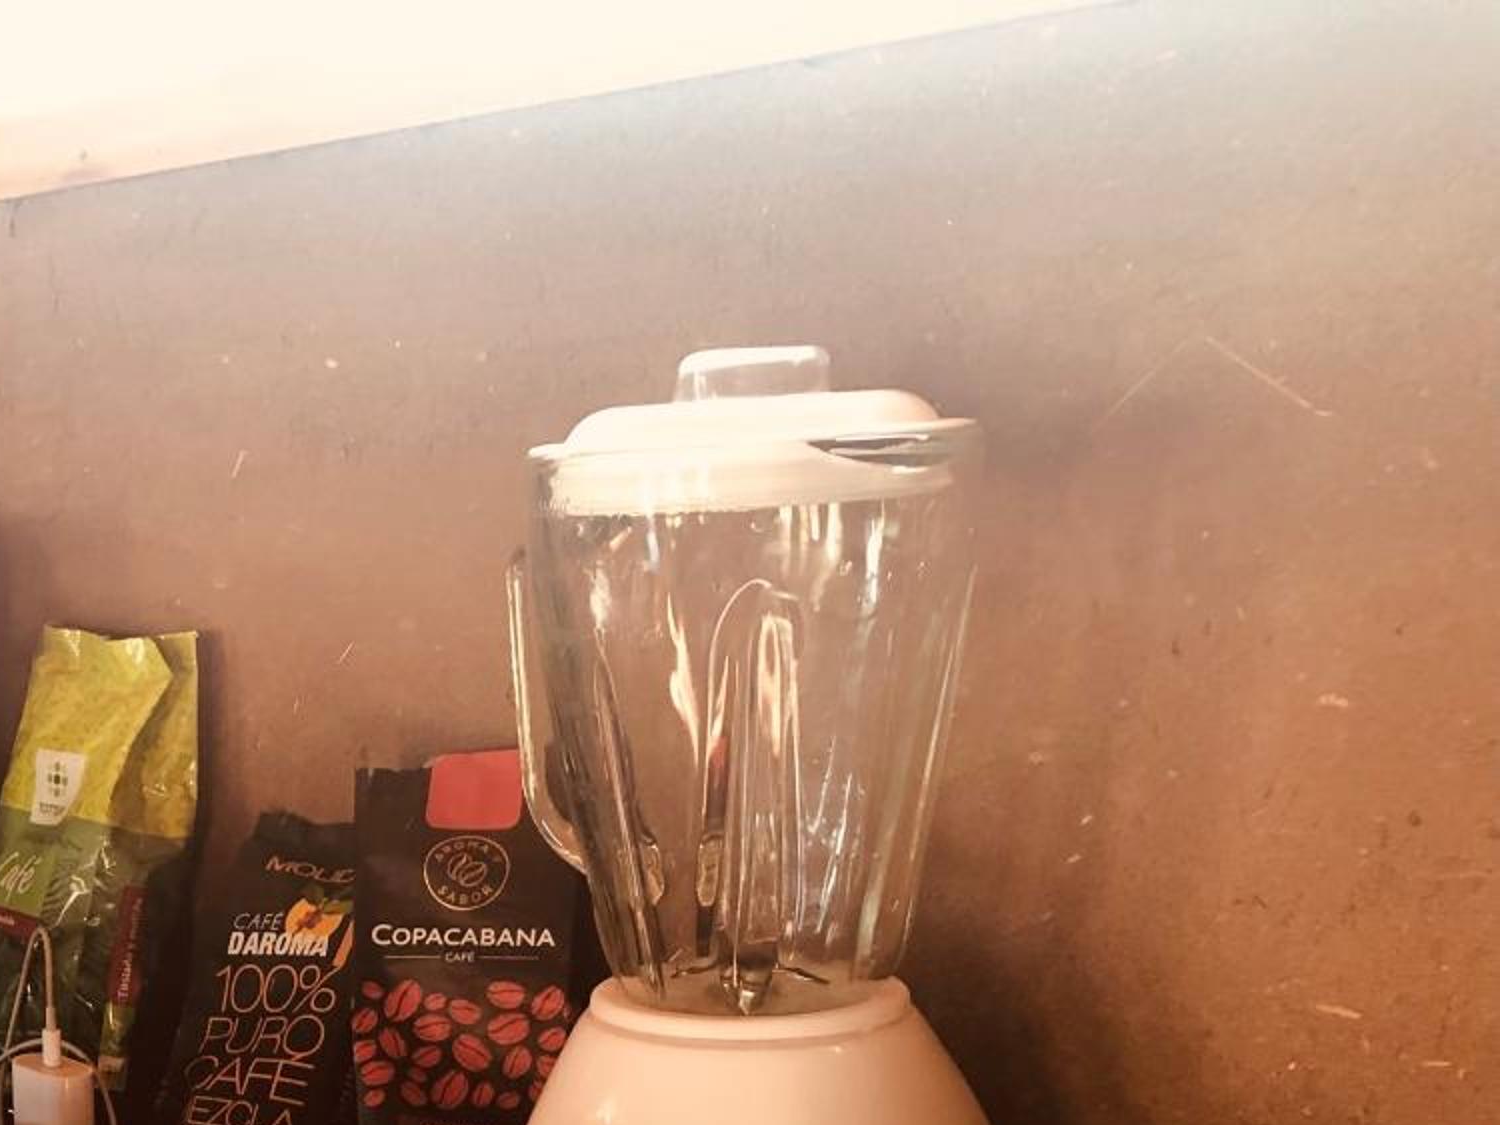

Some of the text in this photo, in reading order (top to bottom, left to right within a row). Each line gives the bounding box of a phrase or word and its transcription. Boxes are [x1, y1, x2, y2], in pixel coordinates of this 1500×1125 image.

[227, 931, 329, 957] DAROMA
[371, 923, 556, 947] COPACABANA
[216, 963, 336, 1014] 100%
[199, 1014, 325, 1055] PURO
